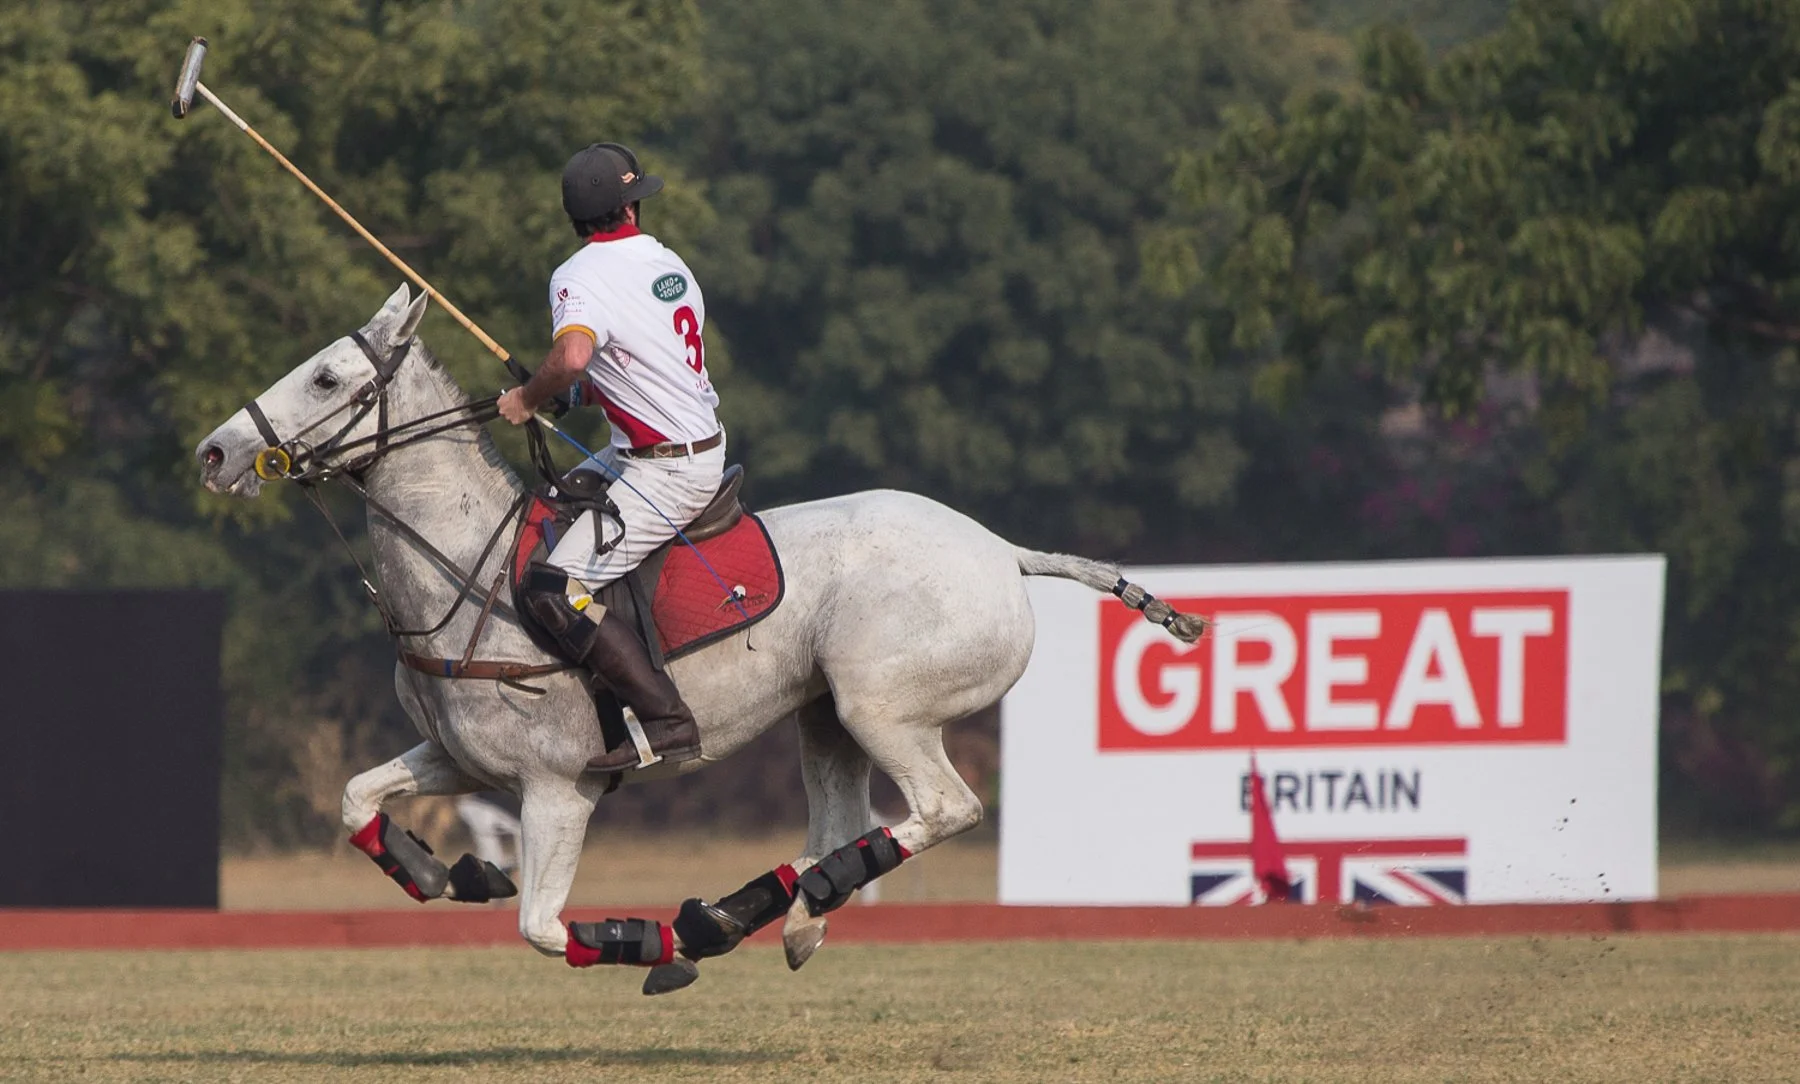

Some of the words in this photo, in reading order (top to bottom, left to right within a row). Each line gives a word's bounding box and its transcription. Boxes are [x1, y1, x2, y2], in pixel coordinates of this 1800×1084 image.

[656, 276, 675, 292] LAND
[663, 282, 684, 298] ROVER
[673, 305, 703, 375] 3
[1113, 606, 1554, 736] GREAT
